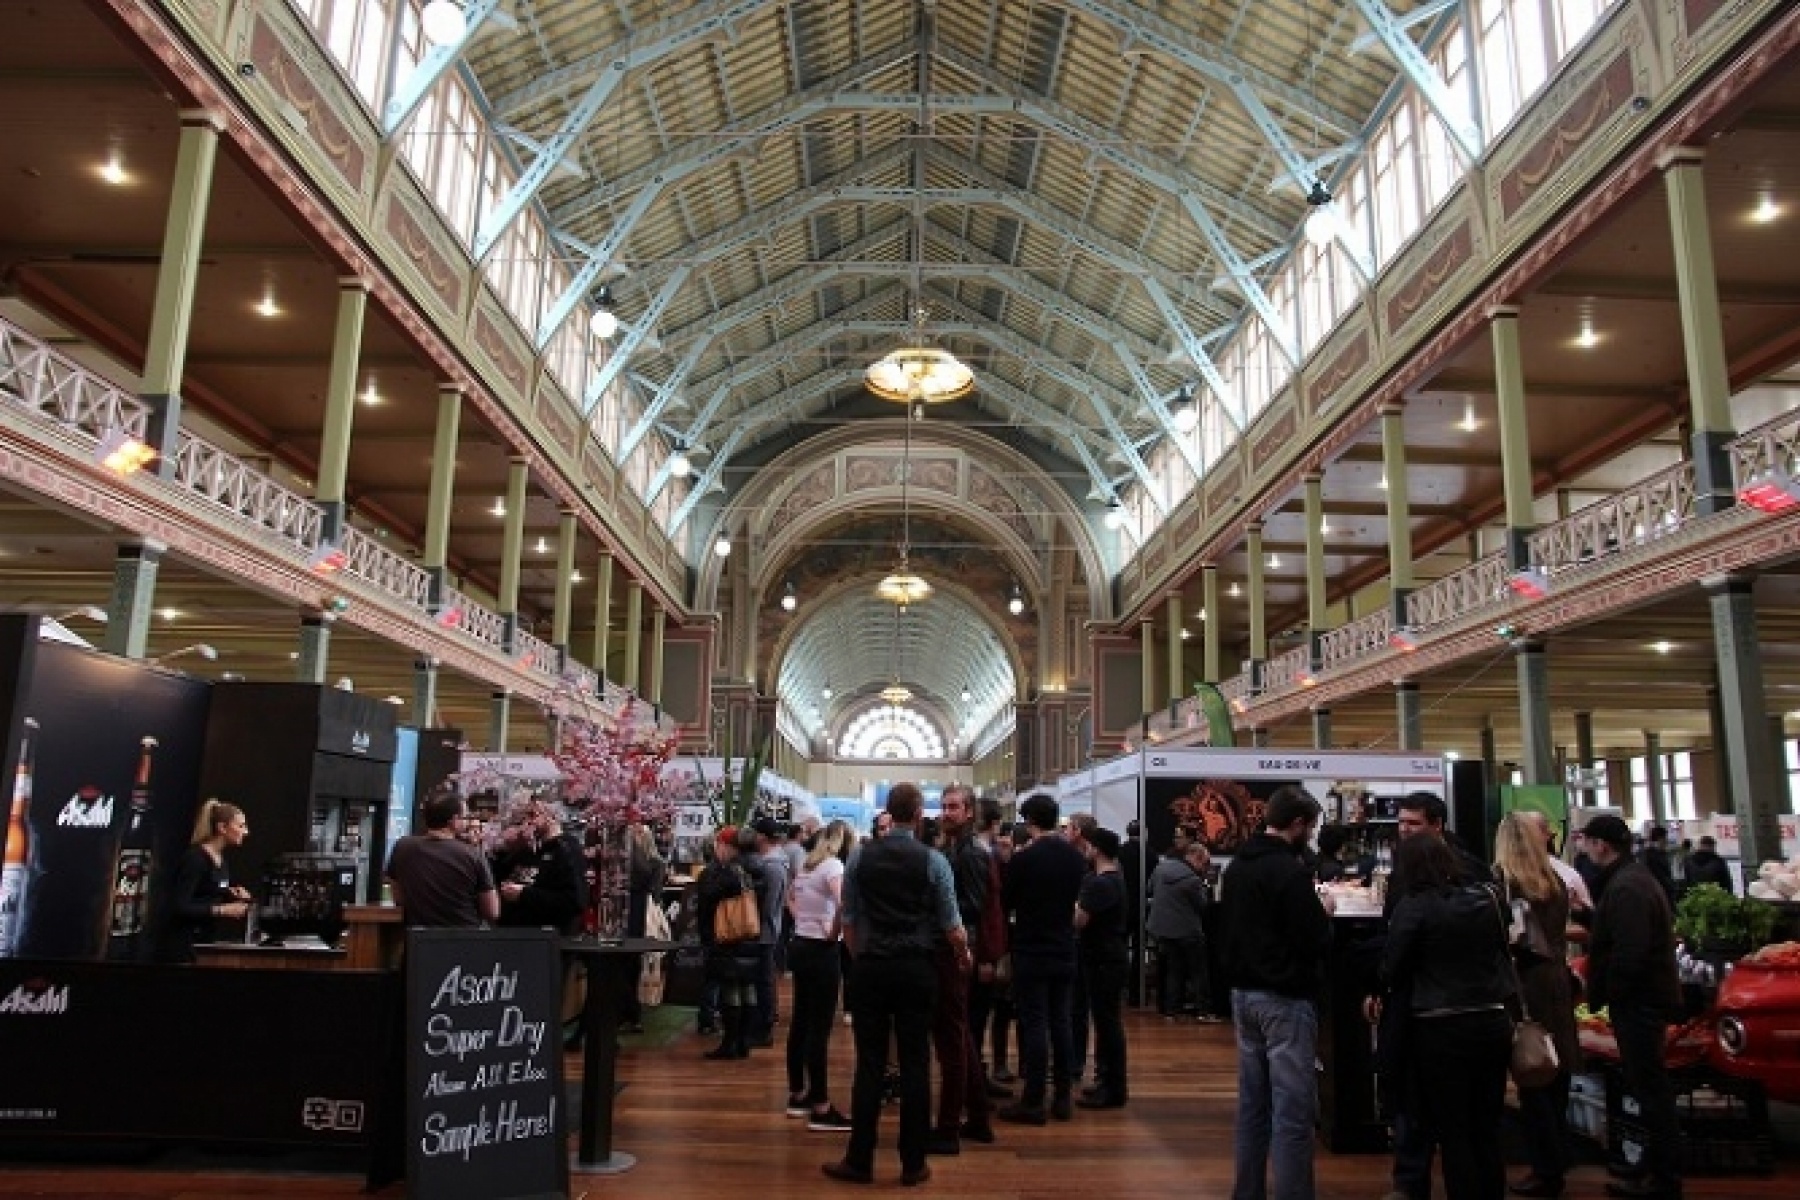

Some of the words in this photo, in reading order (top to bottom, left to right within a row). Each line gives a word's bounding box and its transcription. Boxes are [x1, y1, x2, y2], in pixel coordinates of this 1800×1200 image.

[56, 792, 114, 828] Asahi
[0, 983, 70, 1014] Asahi
[430, 962, 519, 1010] Asahi
[423, 1013, 494, 1063] Super
[498, 1005, 546, 1055] Dry
[420, 1105, 493, 1162] Sample
[495, 1095, 557, 1142] Here!
